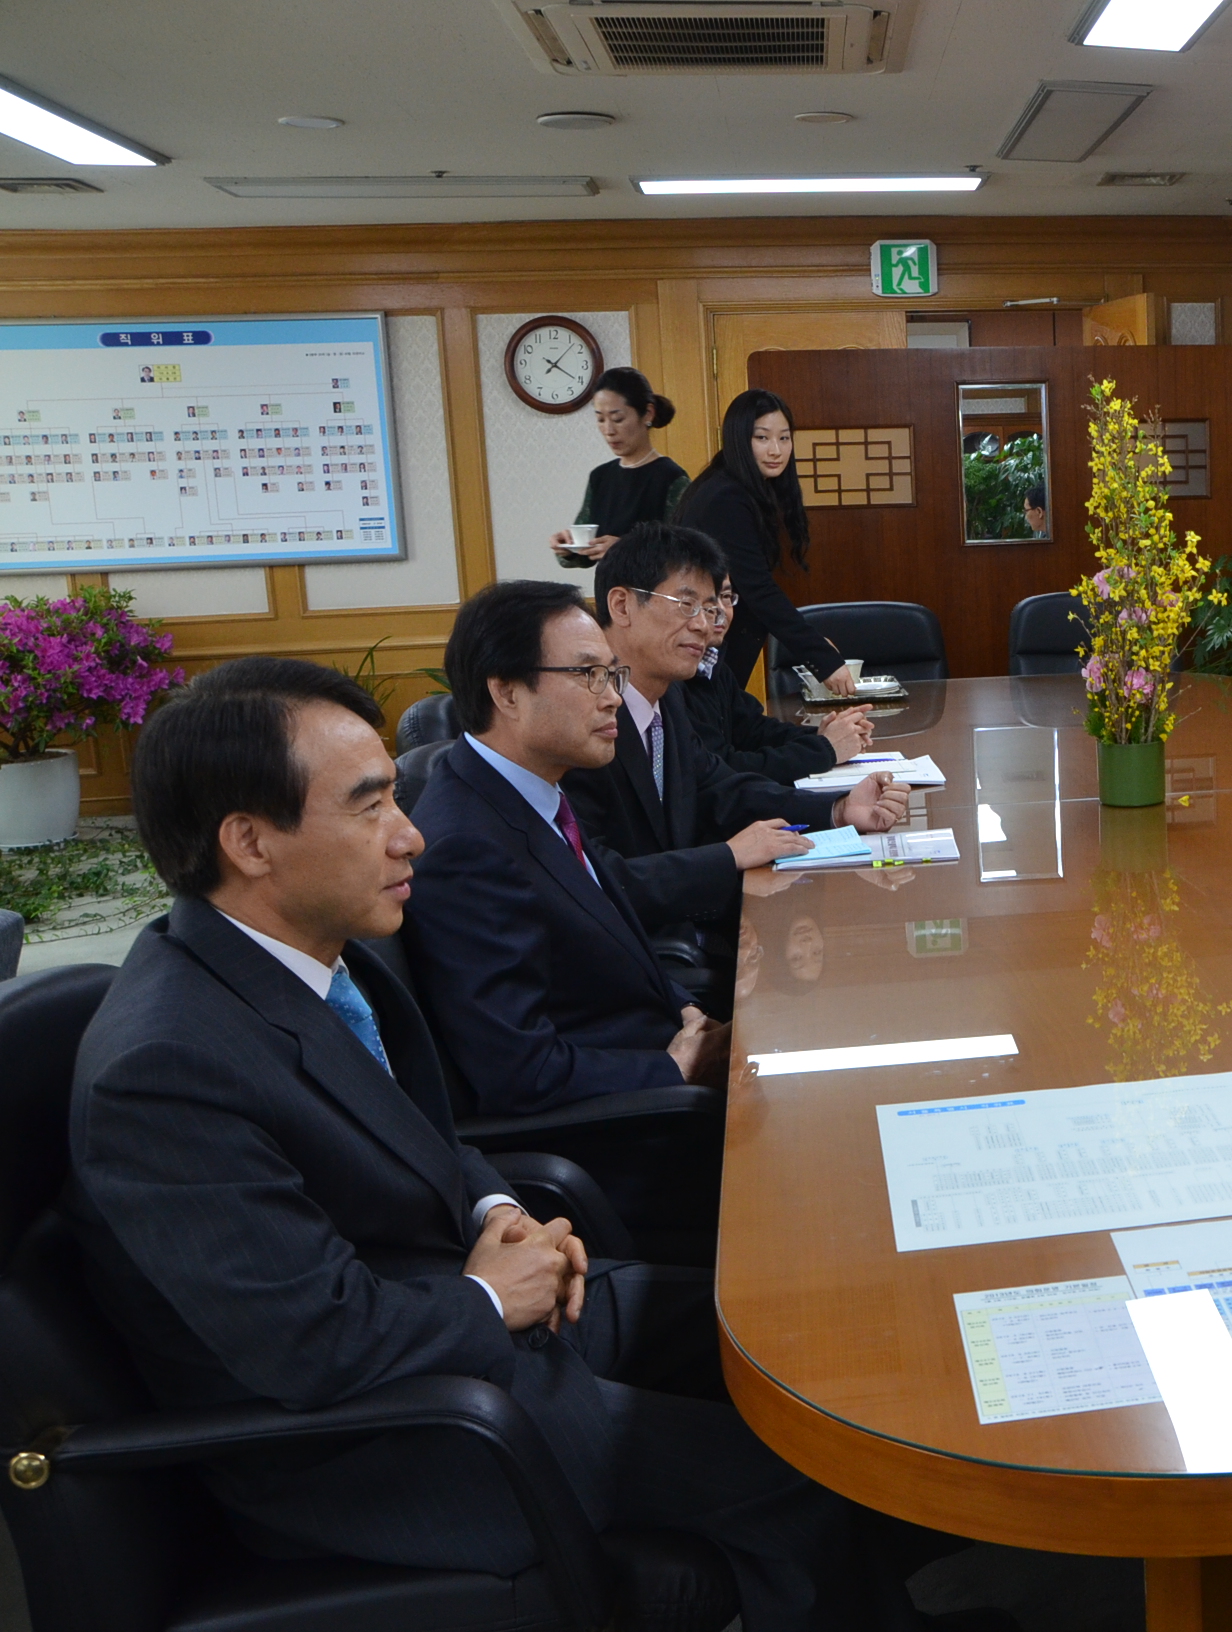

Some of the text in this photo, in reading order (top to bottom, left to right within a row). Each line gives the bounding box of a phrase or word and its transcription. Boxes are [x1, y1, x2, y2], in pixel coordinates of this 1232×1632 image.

[534, 333, 542, 344] 11
[548, 329, 559, 340] 12
[523, 344, 533, 355] 10
[577, 344, 584, 354] 2
[519, 358, 528, 368] 9
[581, 360, 589, 370] 3
[523, 375, 532, 385] 8
[577, 375, 584, 386] 4
[536, 386, 544, 397] 7
[551, 390, 559, 401] 6
[566, 386, 574, 396] 5
